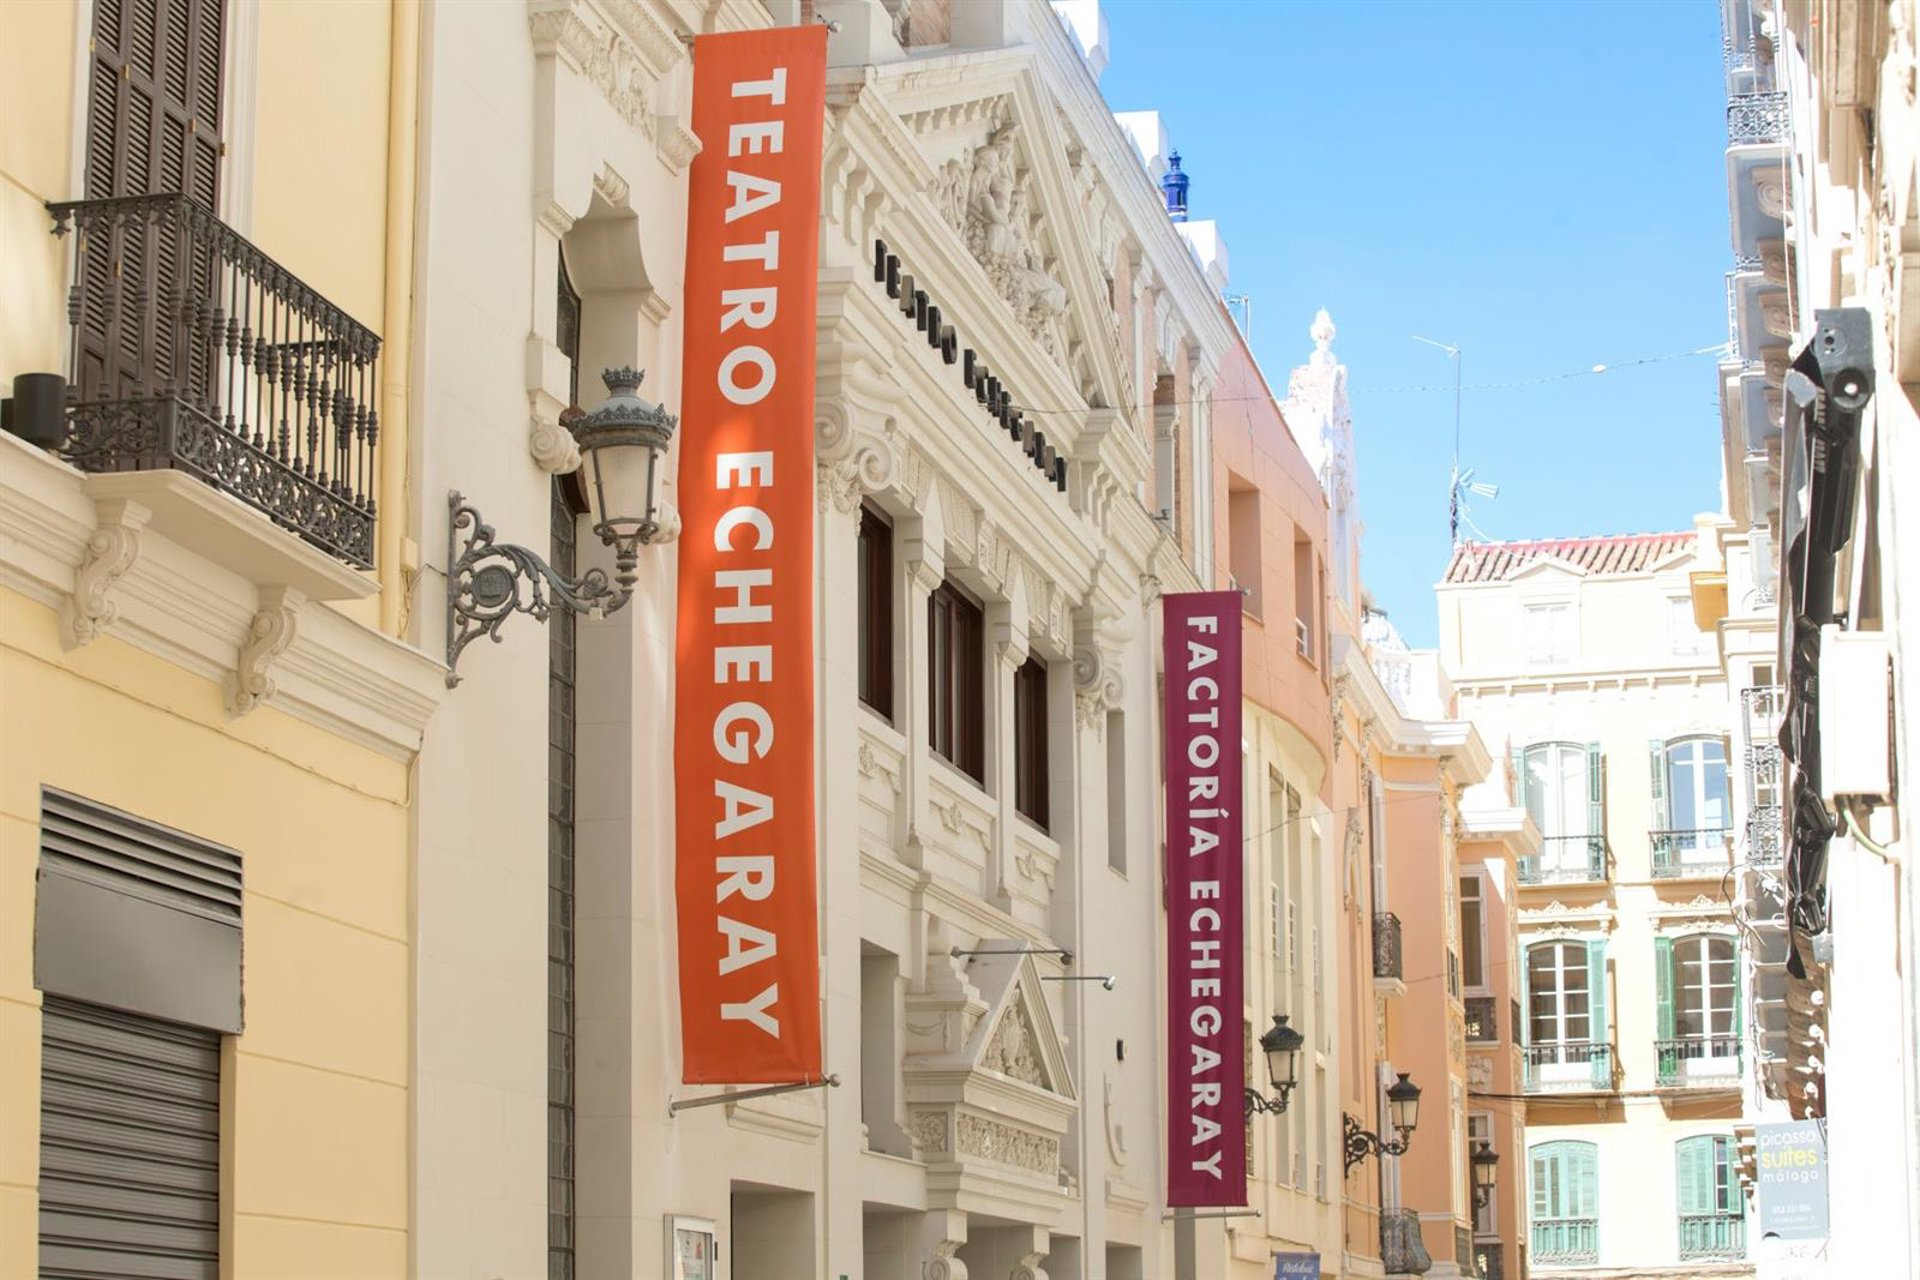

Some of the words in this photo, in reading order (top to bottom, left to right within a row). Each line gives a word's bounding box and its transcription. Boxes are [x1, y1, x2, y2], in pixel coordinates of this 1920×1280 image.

[718, 68, 787, 404] TEATRO
[713, 451, 779, 1038] ECHEGARAY
[1187, 616, 1229, 856] FACTORÍA
[1189, 881, 1222, 1180] ECHEGARAY
[1760, 1129, 1816, 1149] picasso
[1762, 1147, 1818, 1168] suites
